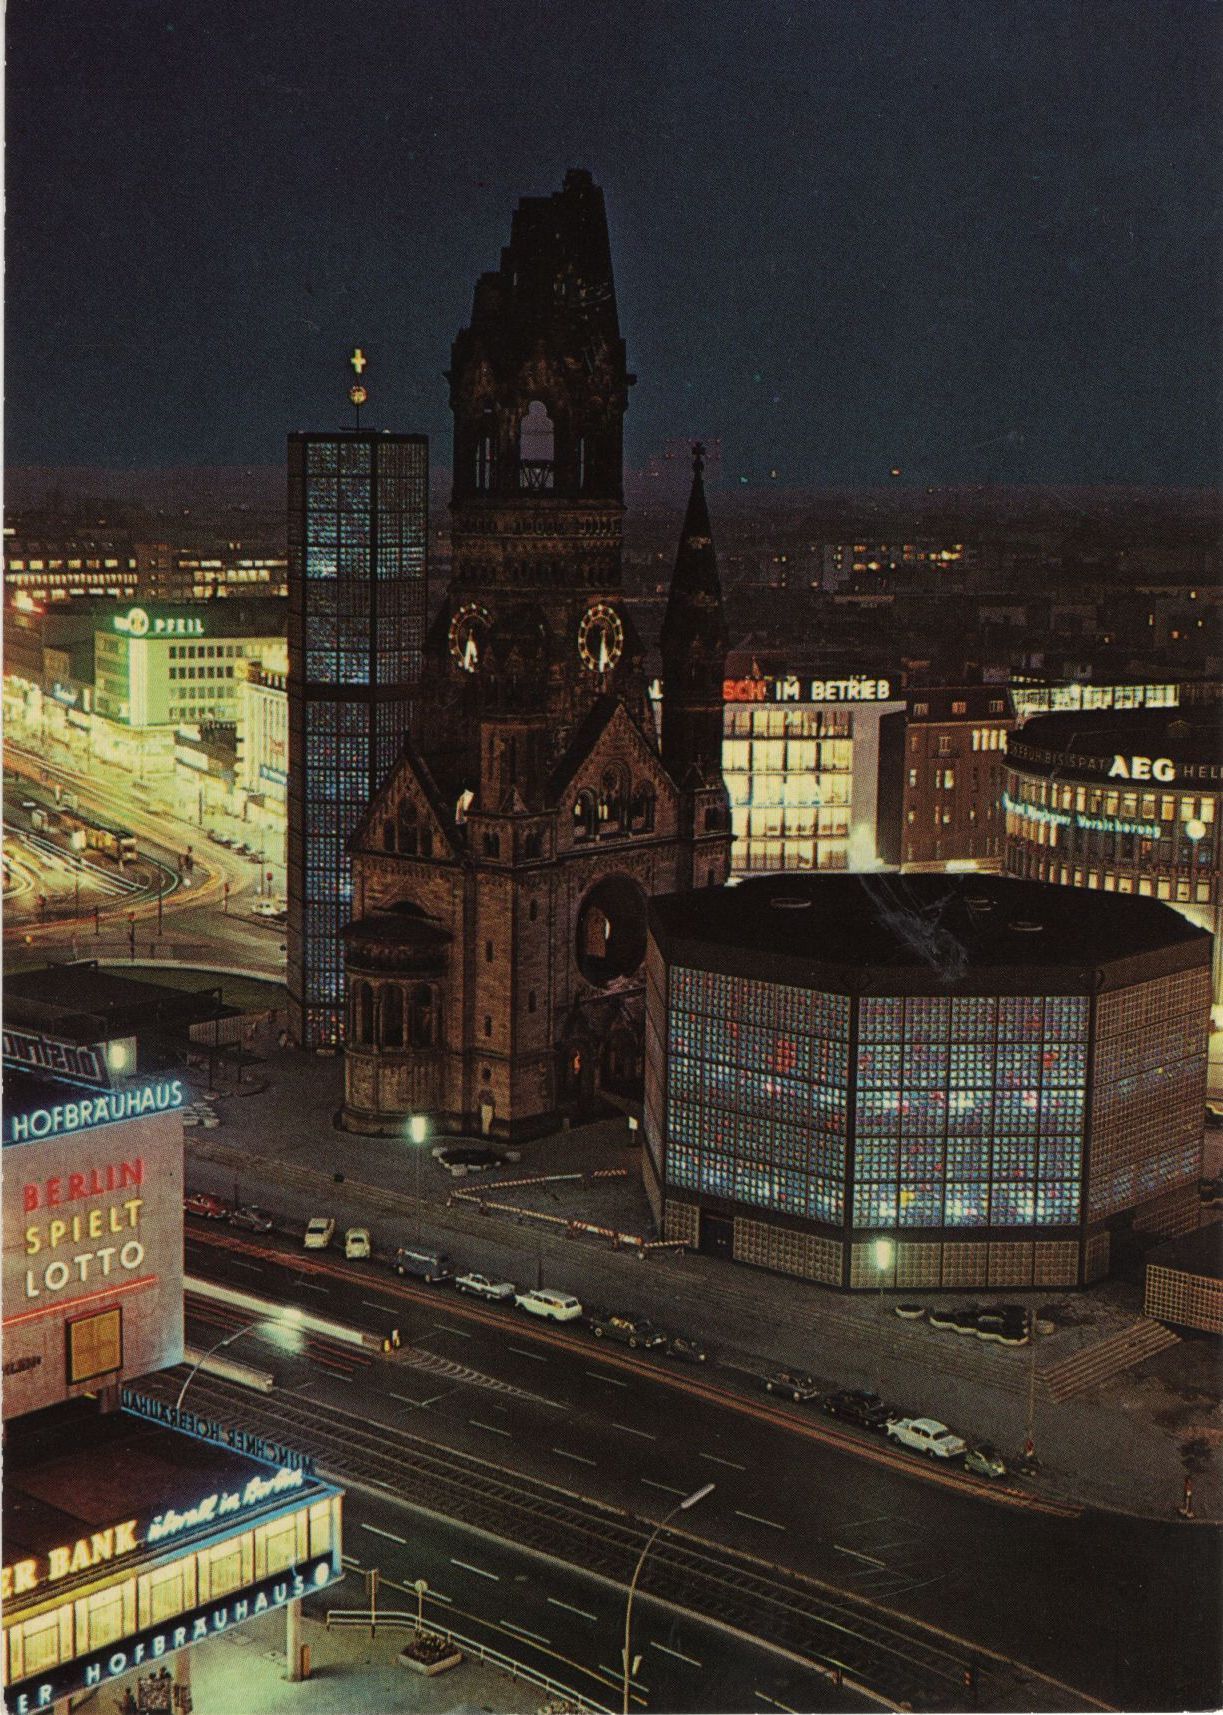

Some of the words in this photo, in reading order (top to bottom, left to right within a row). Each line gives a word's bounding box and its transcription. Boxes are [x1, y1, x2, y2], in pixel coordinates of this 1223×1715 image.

[775, 680, 800, 701] IM
[811, 680, 890, 701] BETRIEB
[1107, 754, 1177, 782] AEG
[21, 1156, 145, 1214] BERLIN
[25, 1198, 144, 1255] SPIELT
[25, 1240, 144, 1298] LOTTO
[48, 1519, 138, 1581] BANK
